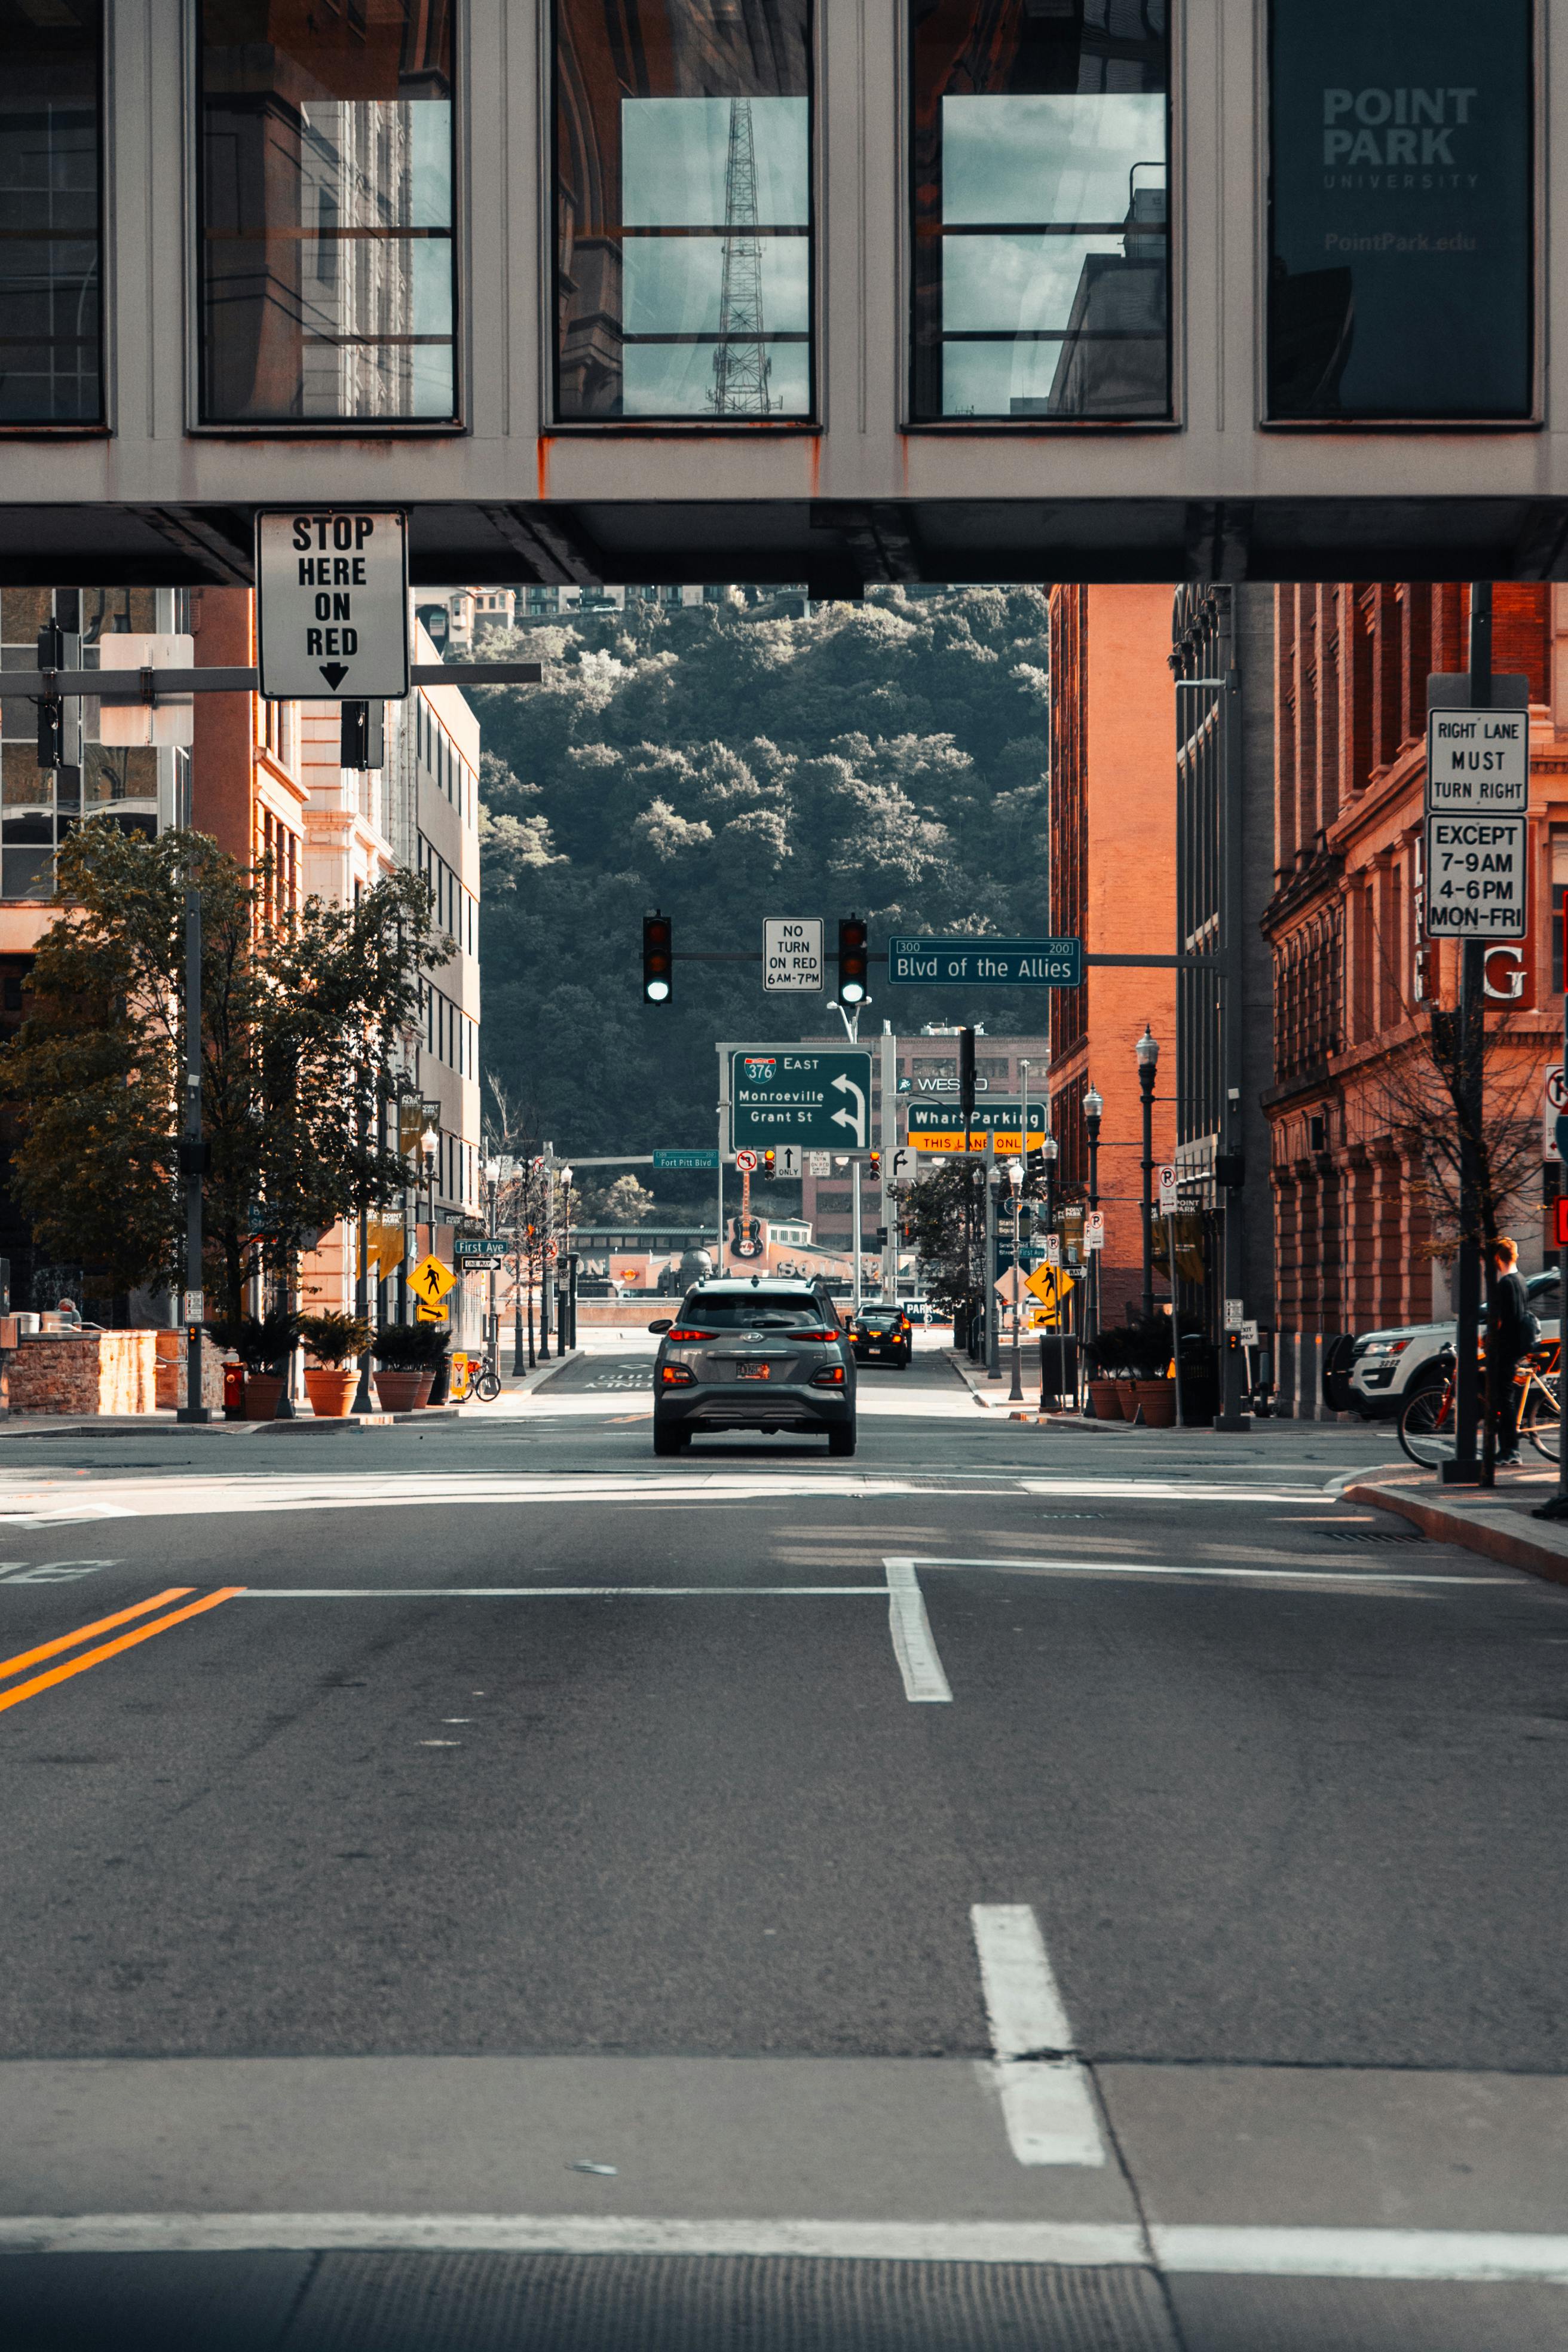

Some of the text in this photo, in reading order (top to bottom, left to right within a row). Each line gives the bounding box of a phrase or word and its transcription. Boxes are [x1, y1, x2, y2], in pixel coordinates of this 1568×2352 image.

[1323, 87, 1478, 125] POINT
[1323, 128, 1456, 166] PARK
[1324, 174, 1479, 189] UNIVERSITY
[1324, 231, 1478, 252] PointPark.edu
[292, 516, 375, 552] STOP
[298, 557, 367, 586] HERE
[314, 592, 351, 621] ON
[307, 627, 359, 656] RED
[1438, 722, 1520, 740] RIGHT LANE
[1451, 751, 1506, 771] MUST
[1434, 781, 1523, 800] TURN RIGHT
[1437, 825, 1518, 846] EXCEPT
[1441, 852, 1514, 873] 7-9AM
[1440, 879, 1514, 901] 4-6PM
[1431, 905, 1522, 928] MON-FRI
[783, 925, 803, 937] NO
[777, 941, 810, 953] TURN
[900, 942, 920, 952] 300
[1049, 944, 1070, 954] 200
[770, 957, 817, 969] ON RED
[898, 957, 1071, 978] Blvd of the Allies
[767, 973, 819, 985] 6AM-7PM
[749, 1064, 773, 1079] 376
[784, 1058, 819, 1070] EAST
[918, 1078, 988, 1091] WESO
[739, 1090, 824, 1101] Monroeville
[751, 1111, 813, 1122] Grant St
[924, 1138, 951, 1148] THIS
[997, 1138, 1030, 1148] ONL
[460, 1242, 504, 1252] First Ave
